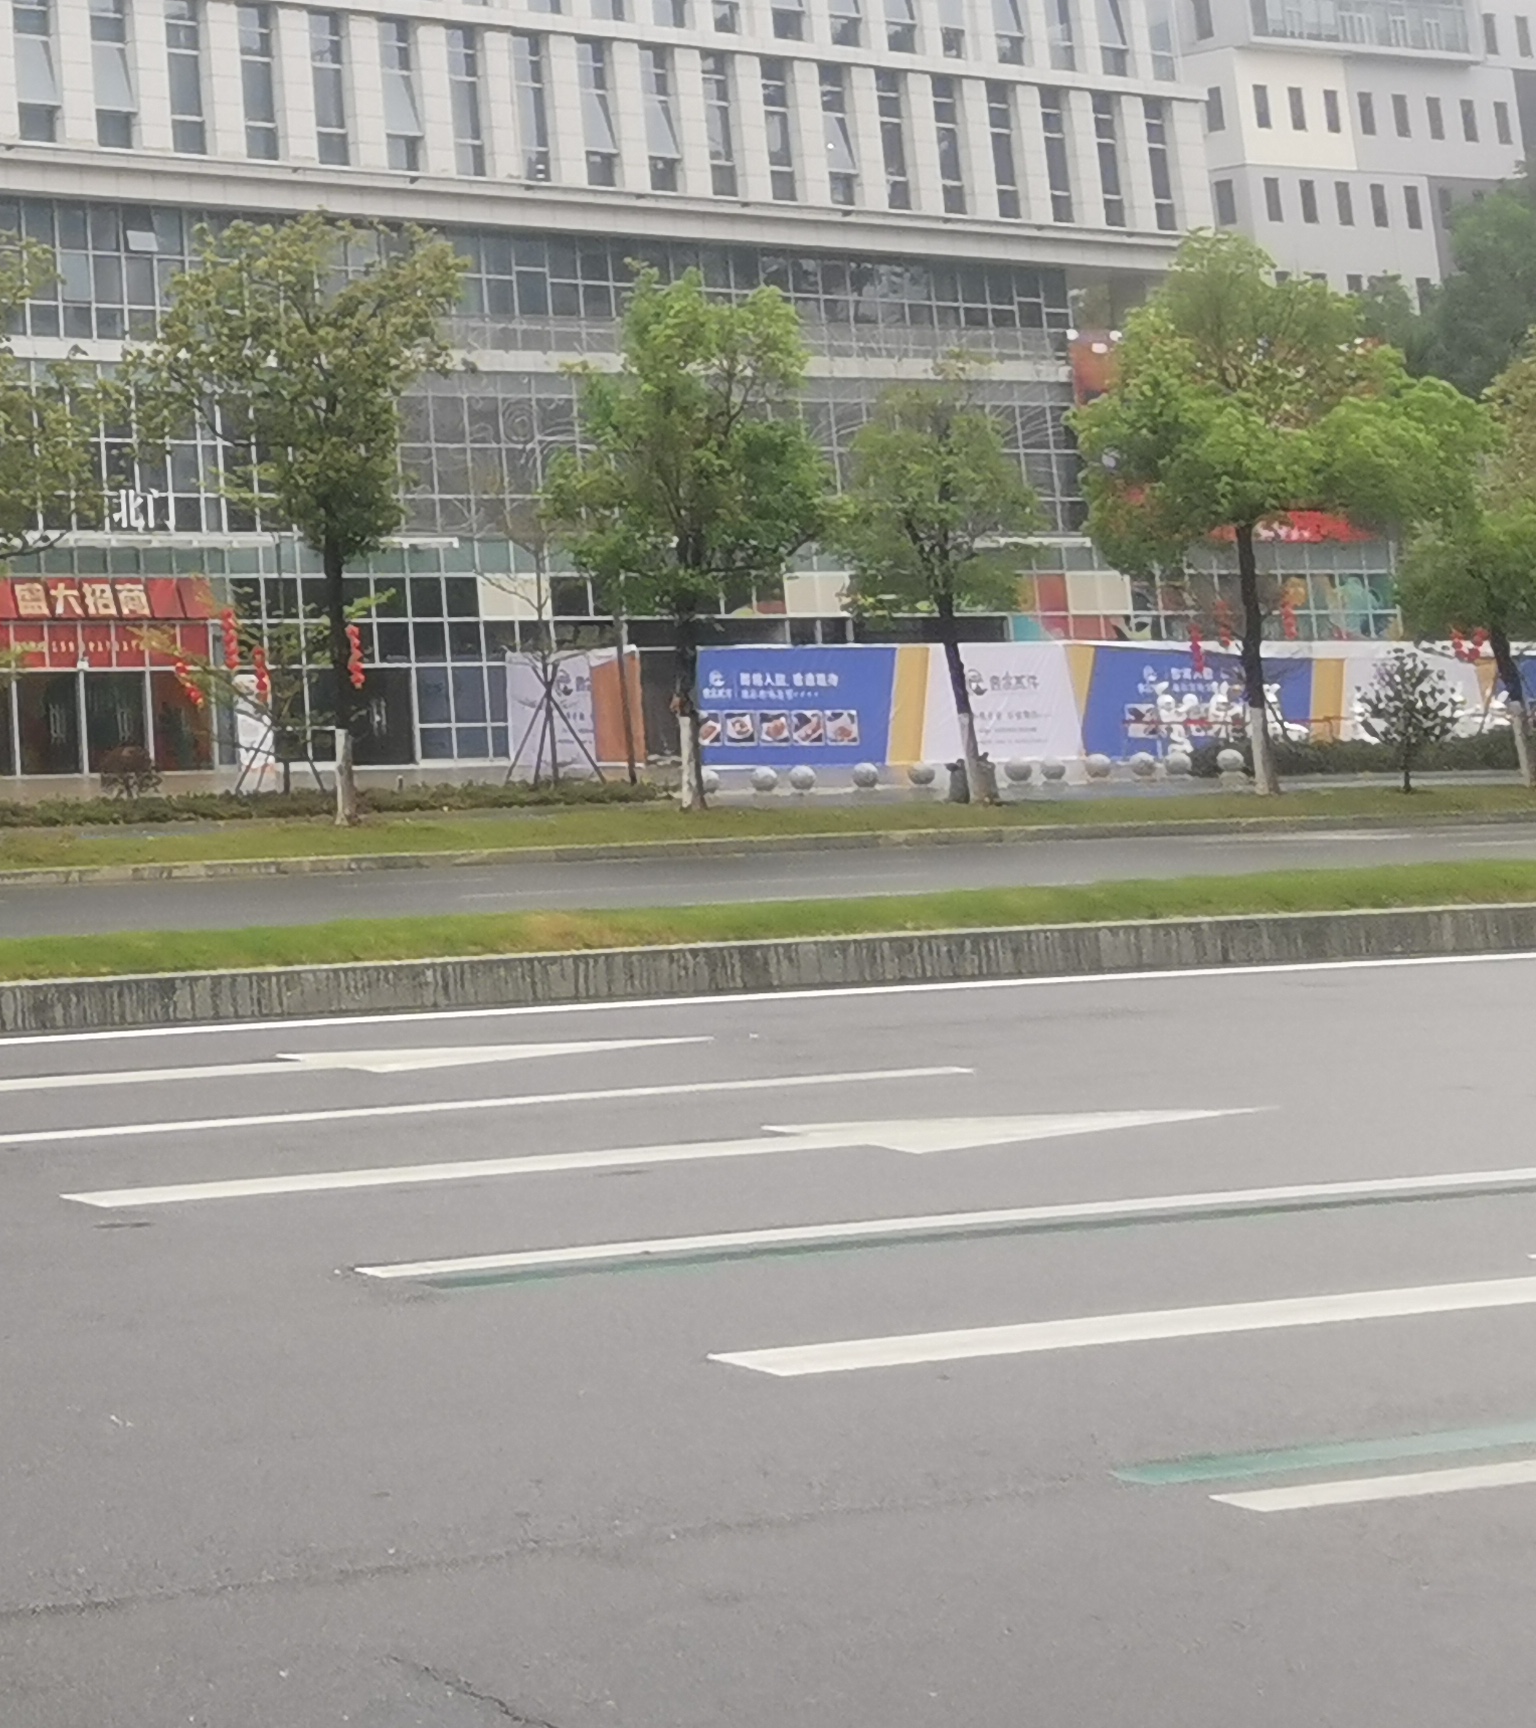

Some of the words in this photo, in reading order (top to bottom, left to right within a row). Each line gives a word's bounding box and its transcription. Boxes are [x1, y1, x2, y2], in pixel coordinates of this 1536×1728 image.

[112, 487, 176, 532] 北门
[14, 582, 152, 616] 盛大招商
